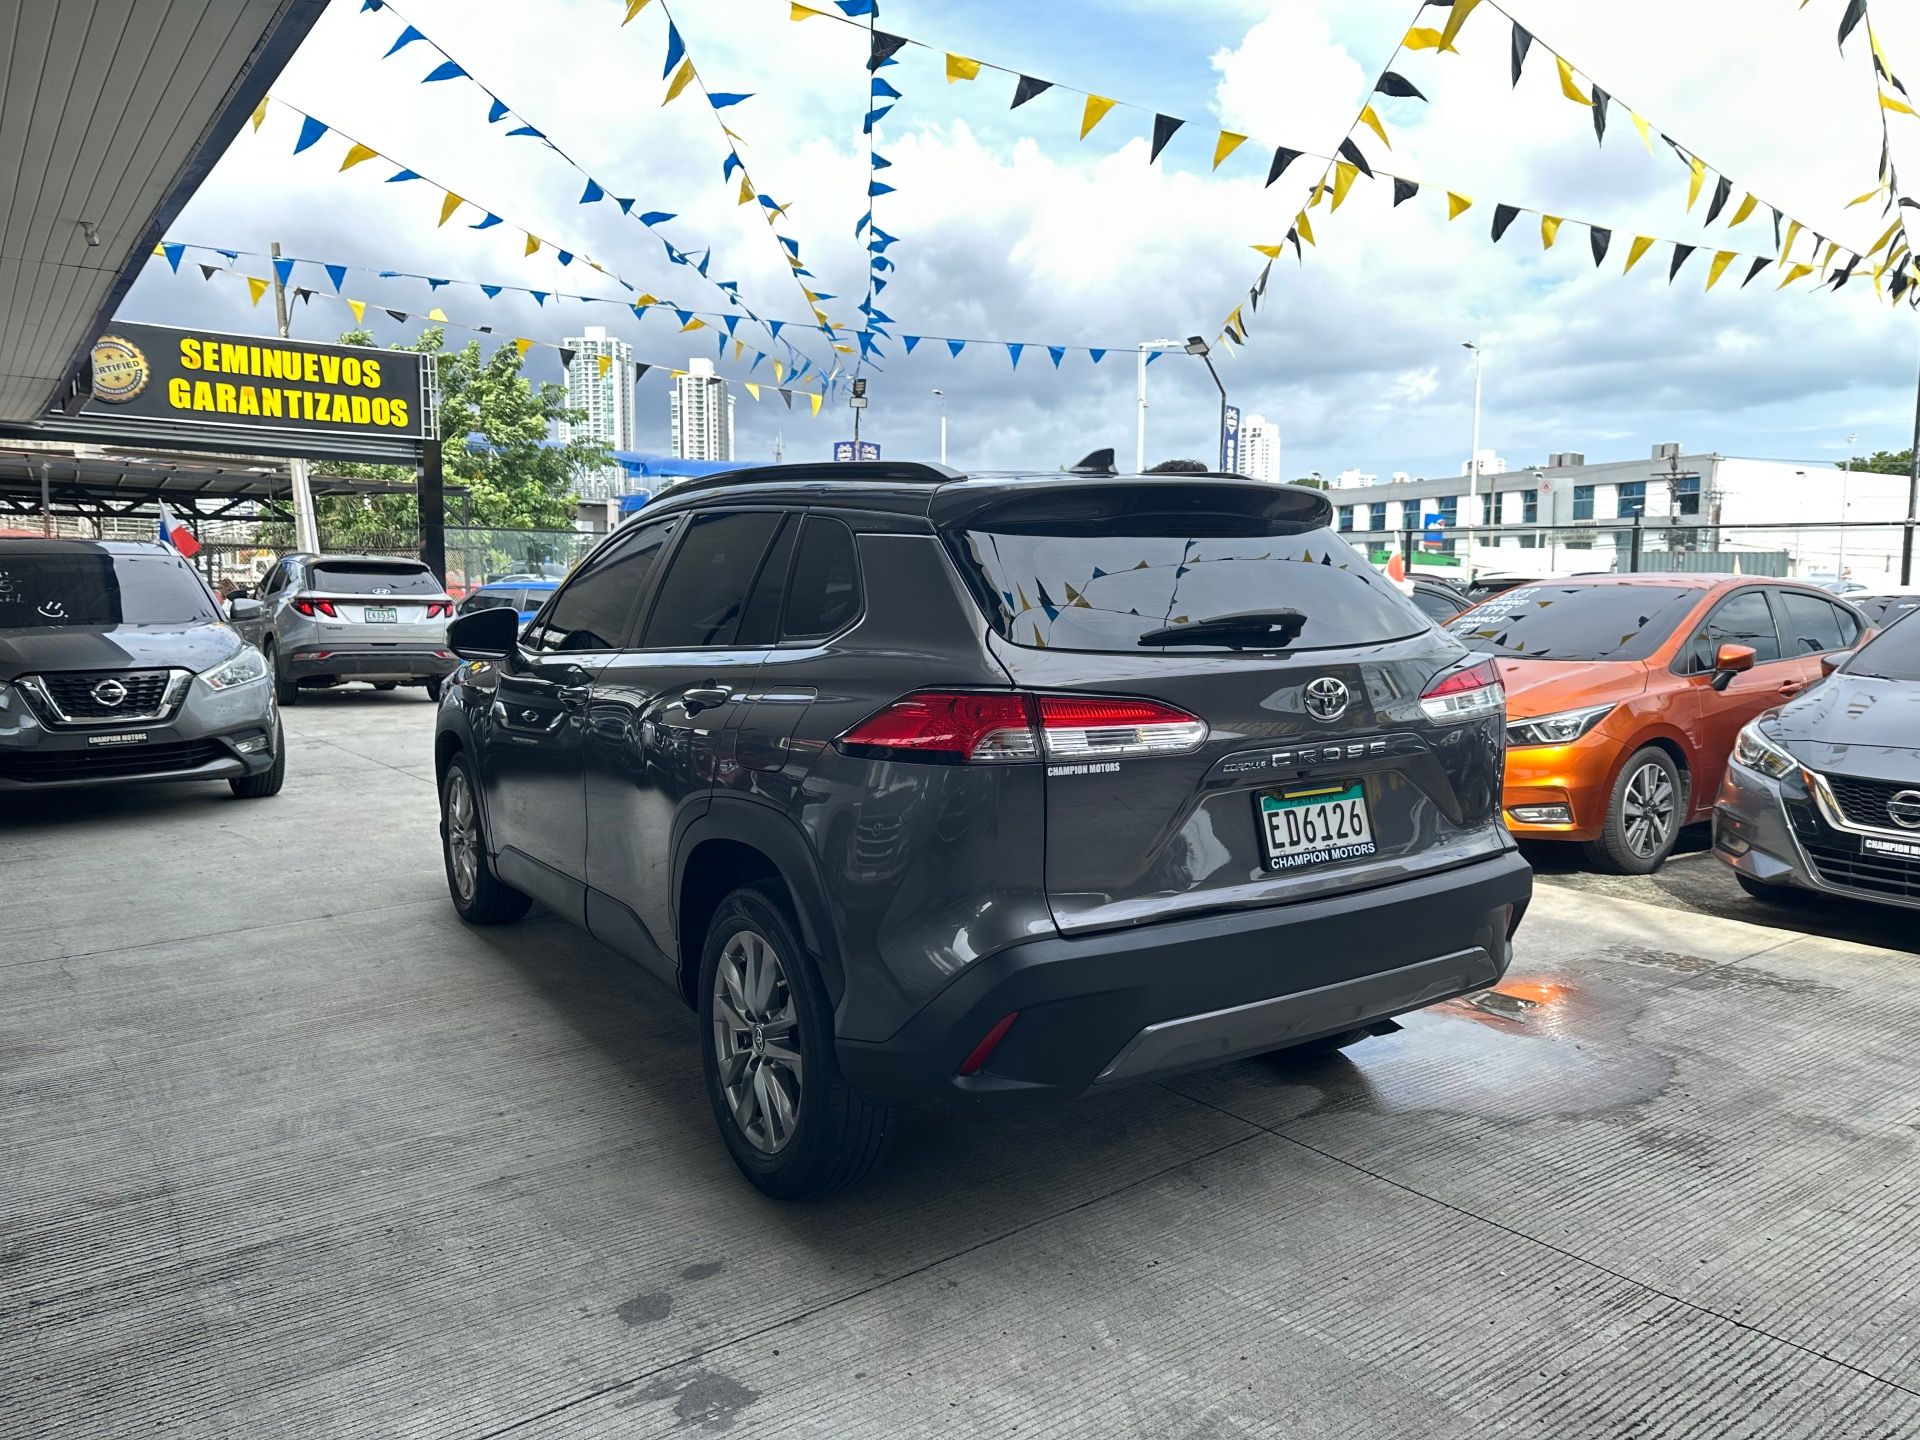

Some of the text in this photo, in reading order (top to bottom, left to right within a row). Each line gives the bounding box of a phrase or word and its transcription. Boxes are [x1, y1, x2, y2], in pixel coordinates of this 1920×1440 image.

[180, 338, 381, 389] SEMINUEVOS
[168, 377, 409, 428] GARANTIZADOS
[88, 735, 121, 743] CHAMPION
[122, 733, 147, 741] MOTORS
[1271, 741, 1387, 767] CROSS
[1047, 762, 1120, 776] CHAMPION MOTORS
[1267, 800, 1363, 850] ED6126
[1271, 850, 1329, 869] CHAMPION
[1331, 842, 1376, 860] MOTORS
[1865, 839, 1910, 853] CHAMPION
